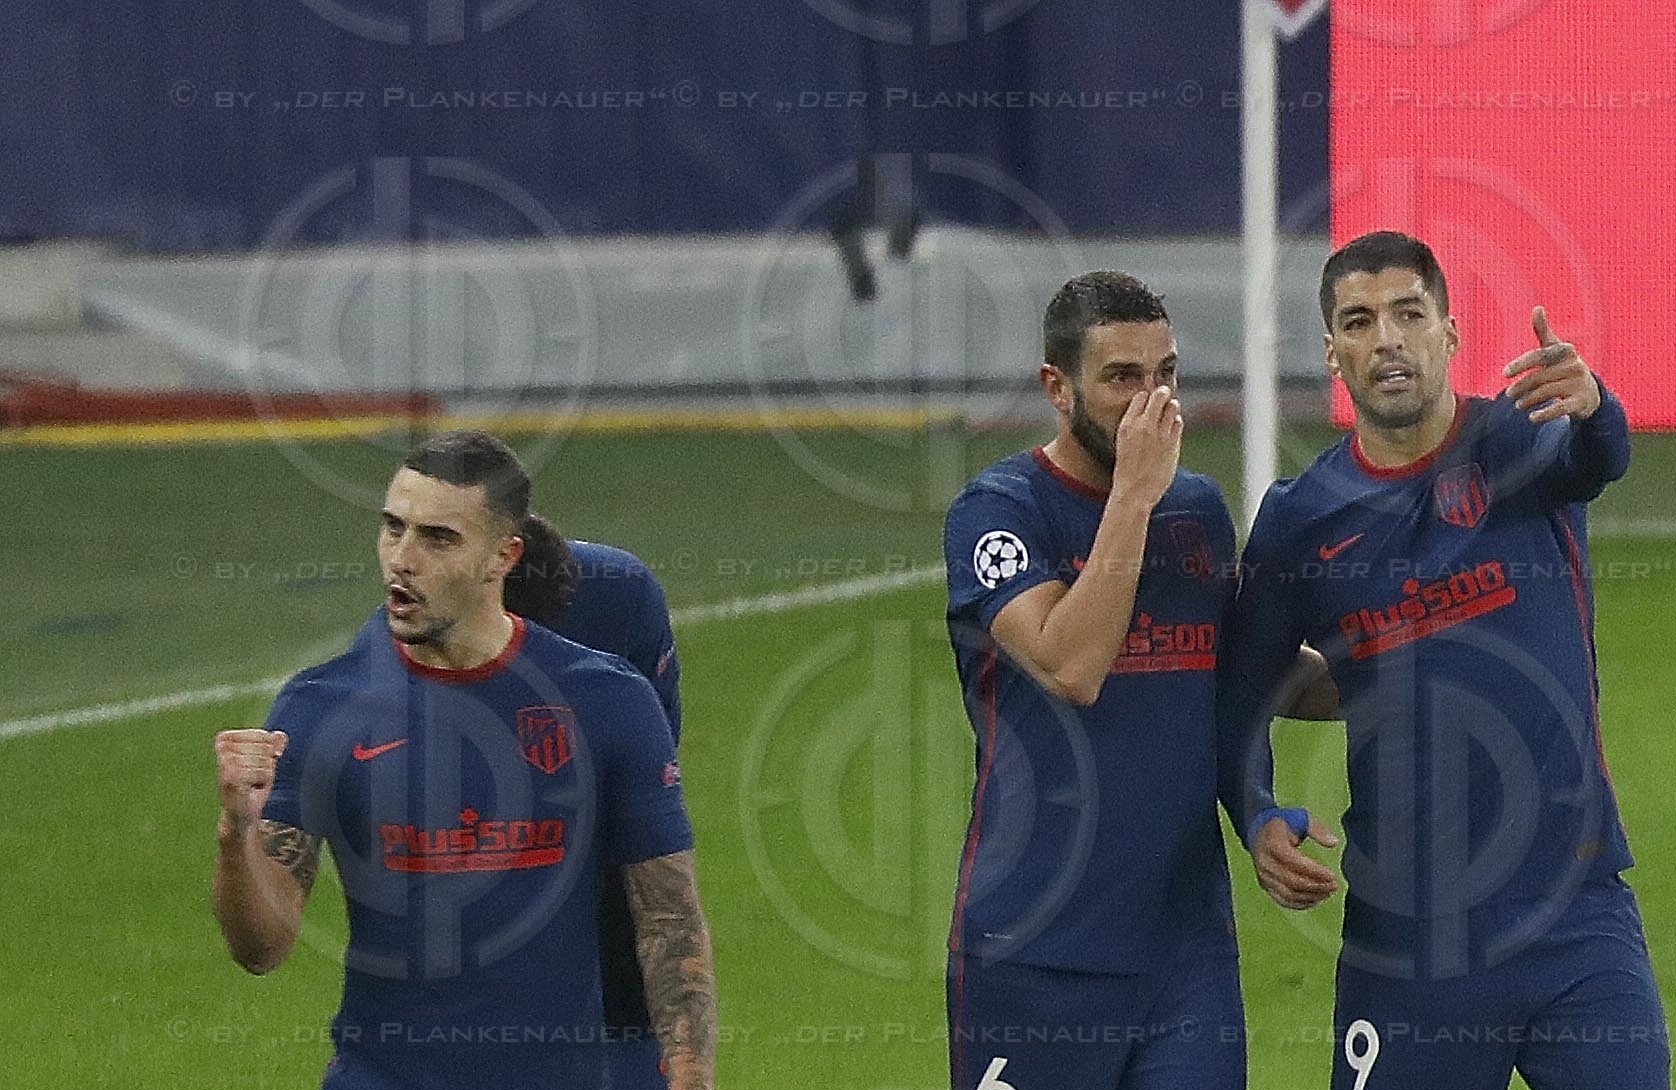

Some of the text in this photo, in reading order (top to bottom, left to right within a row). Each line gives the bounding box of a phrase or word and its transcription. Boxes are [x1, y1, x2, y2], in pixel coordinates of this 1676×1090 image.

[1339, 561, 1505, 642] Plus500
[1120, 613, 1216, 655] s500
[380, 808, 563, 854] Plus500
